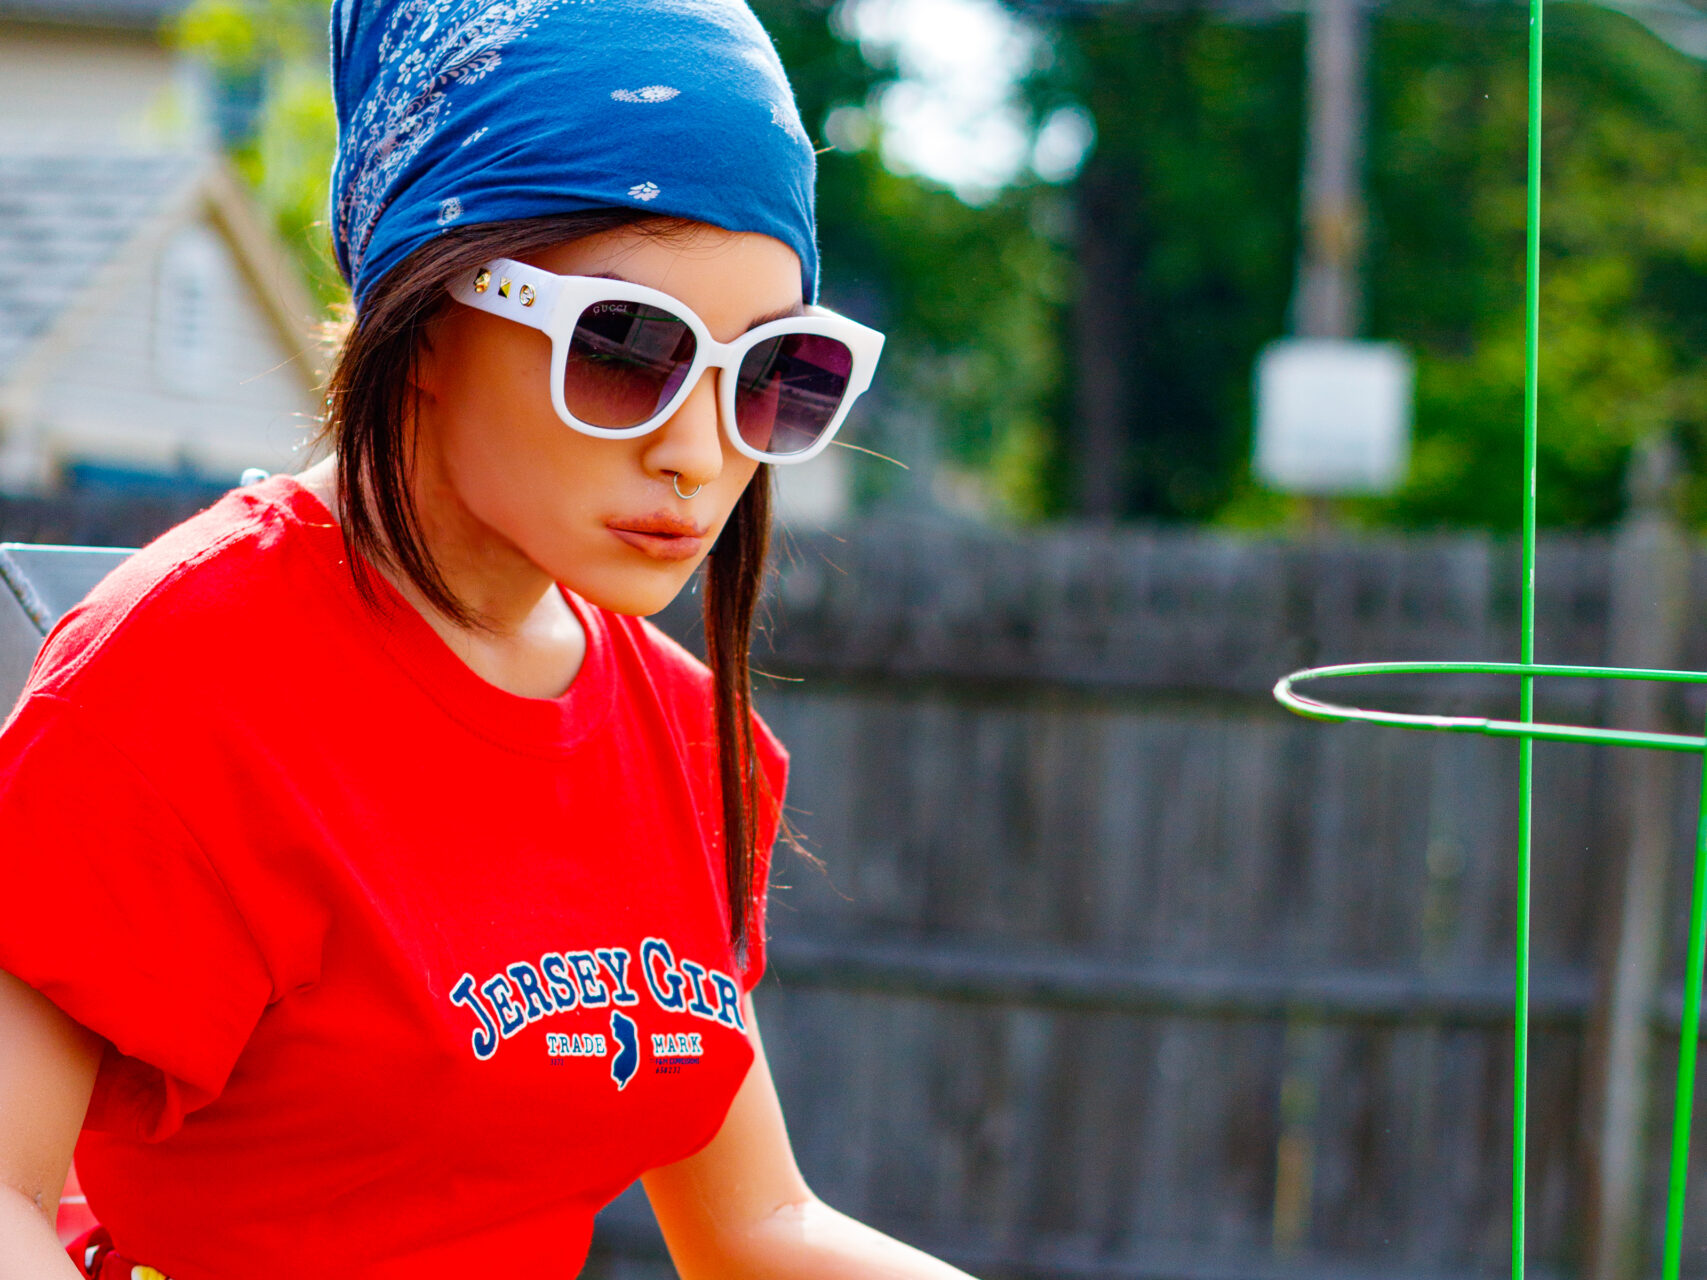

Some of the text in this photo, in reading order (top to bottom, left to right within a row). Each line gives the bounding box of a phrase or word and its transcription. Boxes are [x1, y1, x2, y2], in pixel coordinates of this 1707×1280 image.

[592, 304, 628, 314] GUCCI
[450, 937, 748, 1061] JERSEY GIR
[546, 1033, 704, 1056] TRADE MARK
